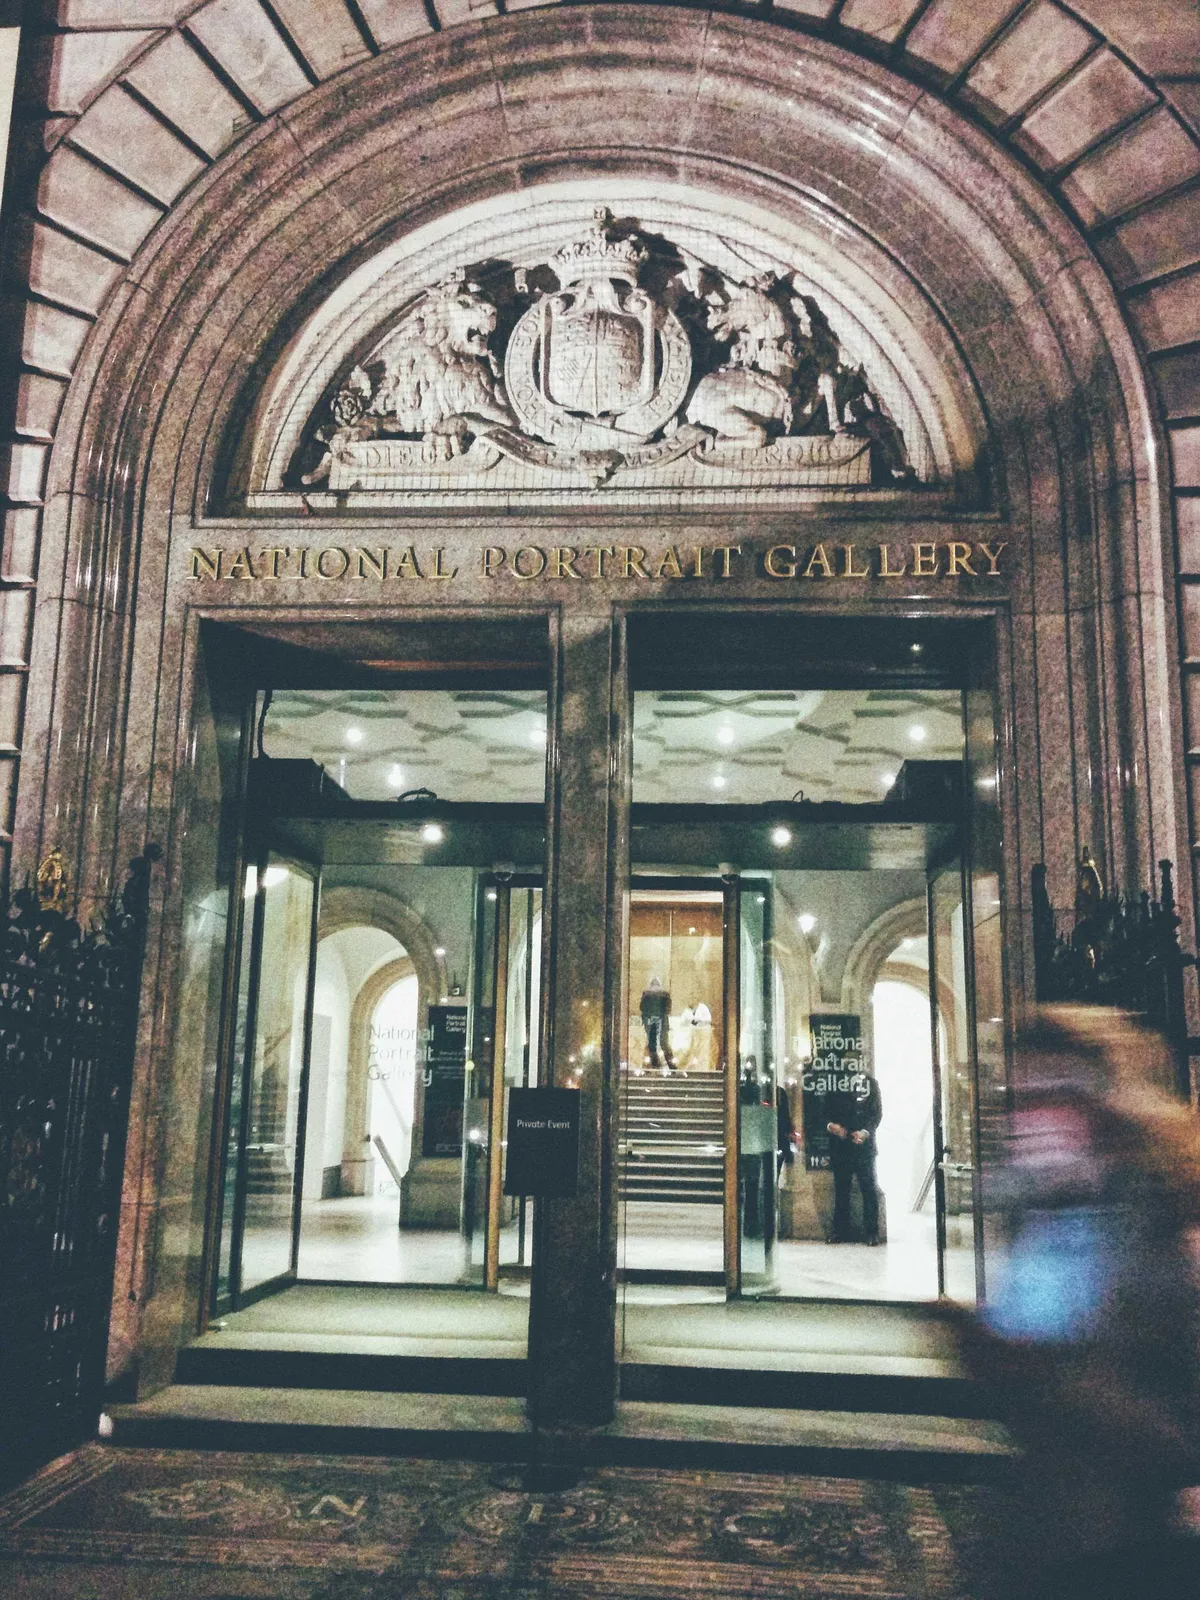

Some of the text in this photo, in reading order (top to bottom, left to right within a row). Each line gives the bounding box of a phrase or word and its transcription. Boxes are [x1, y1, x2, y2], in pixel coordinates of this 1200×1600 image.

[187, 541, 1008, 581] NATIONAL PORTRAIT GALLERY
[802, 1072, 871, 1098] Gallery
[517, 1119, 571, 1129] Private Event
